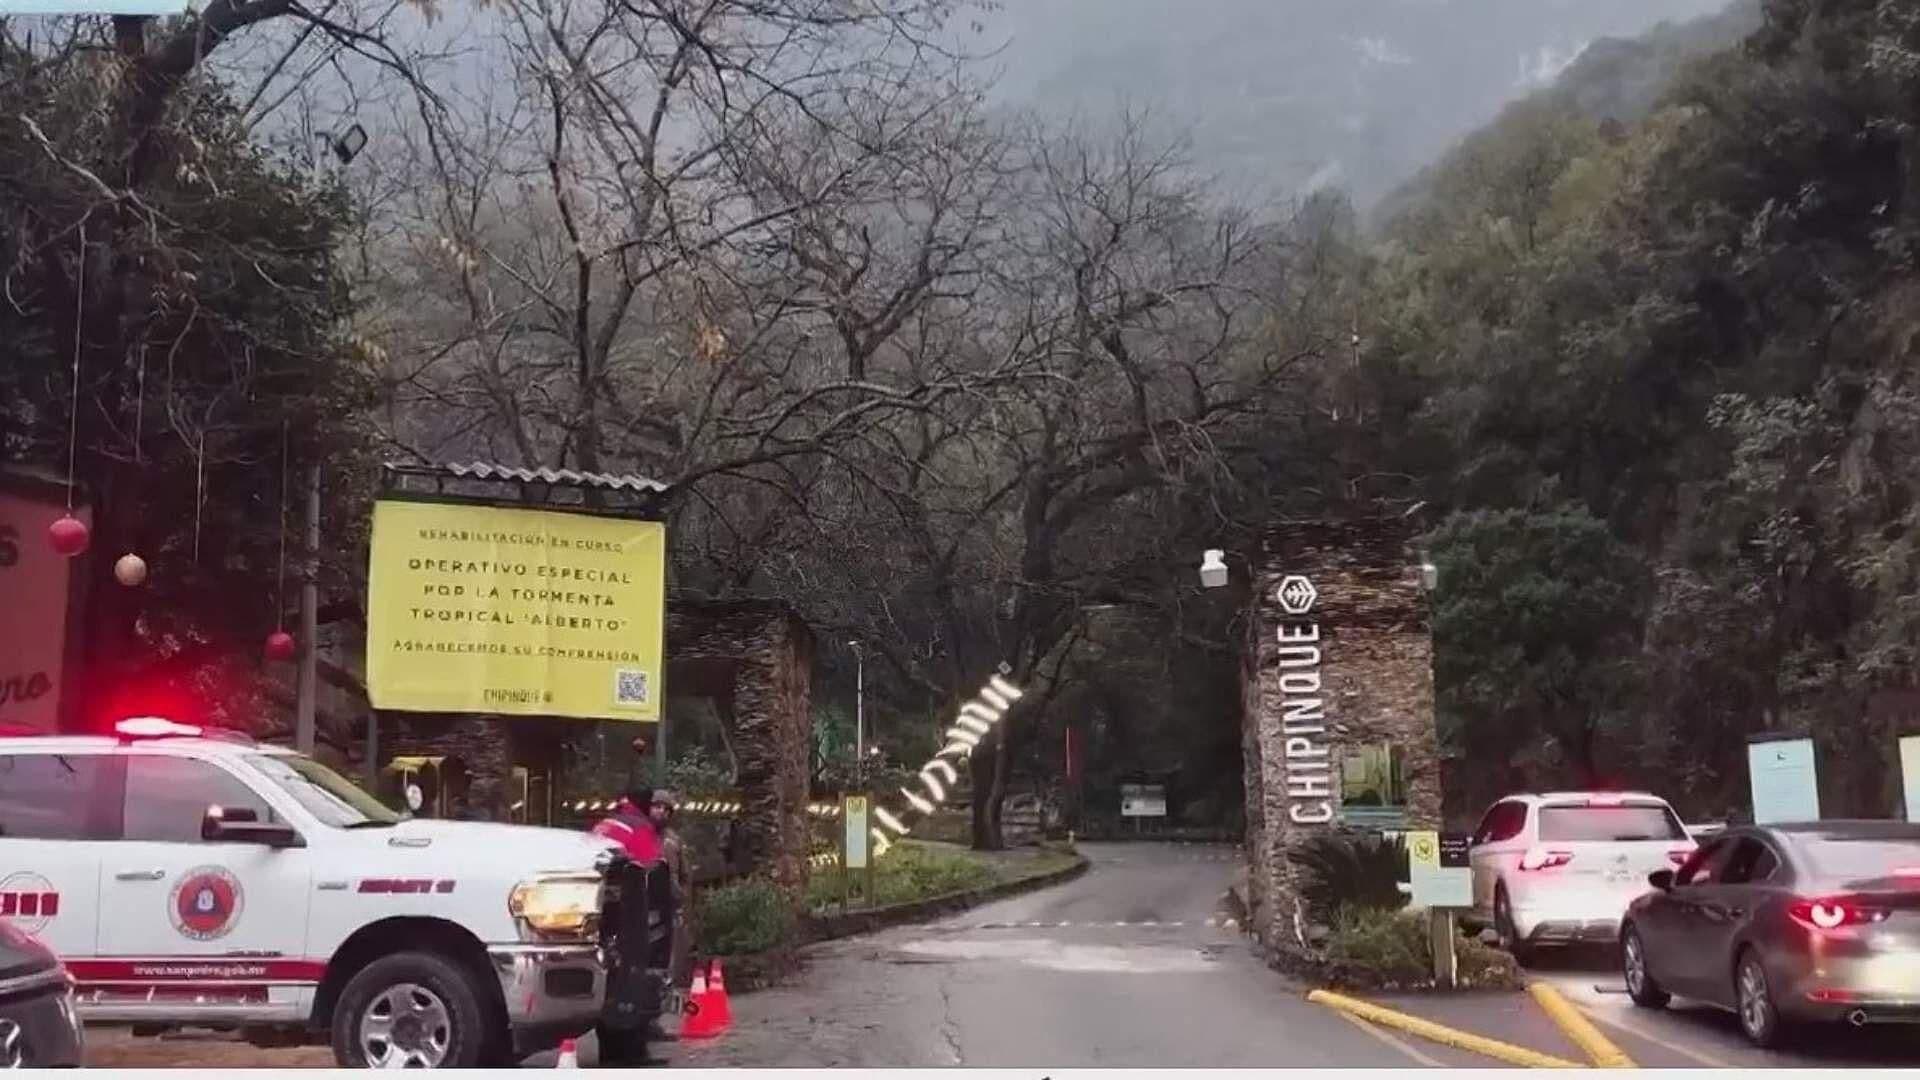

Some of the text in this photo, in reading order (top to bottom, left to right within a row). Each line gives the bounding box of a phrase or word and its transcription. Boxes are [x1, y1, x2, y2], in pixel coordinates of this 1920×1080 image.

[408, 558, 632, 584] OPERATIVO ESPECIAL
[423, 584, 614, 606] POR LA TORMENTA
[410, 608, 515, 624] TROPICAL
[1277, 624, 1333, 824] CHIPINQUE
